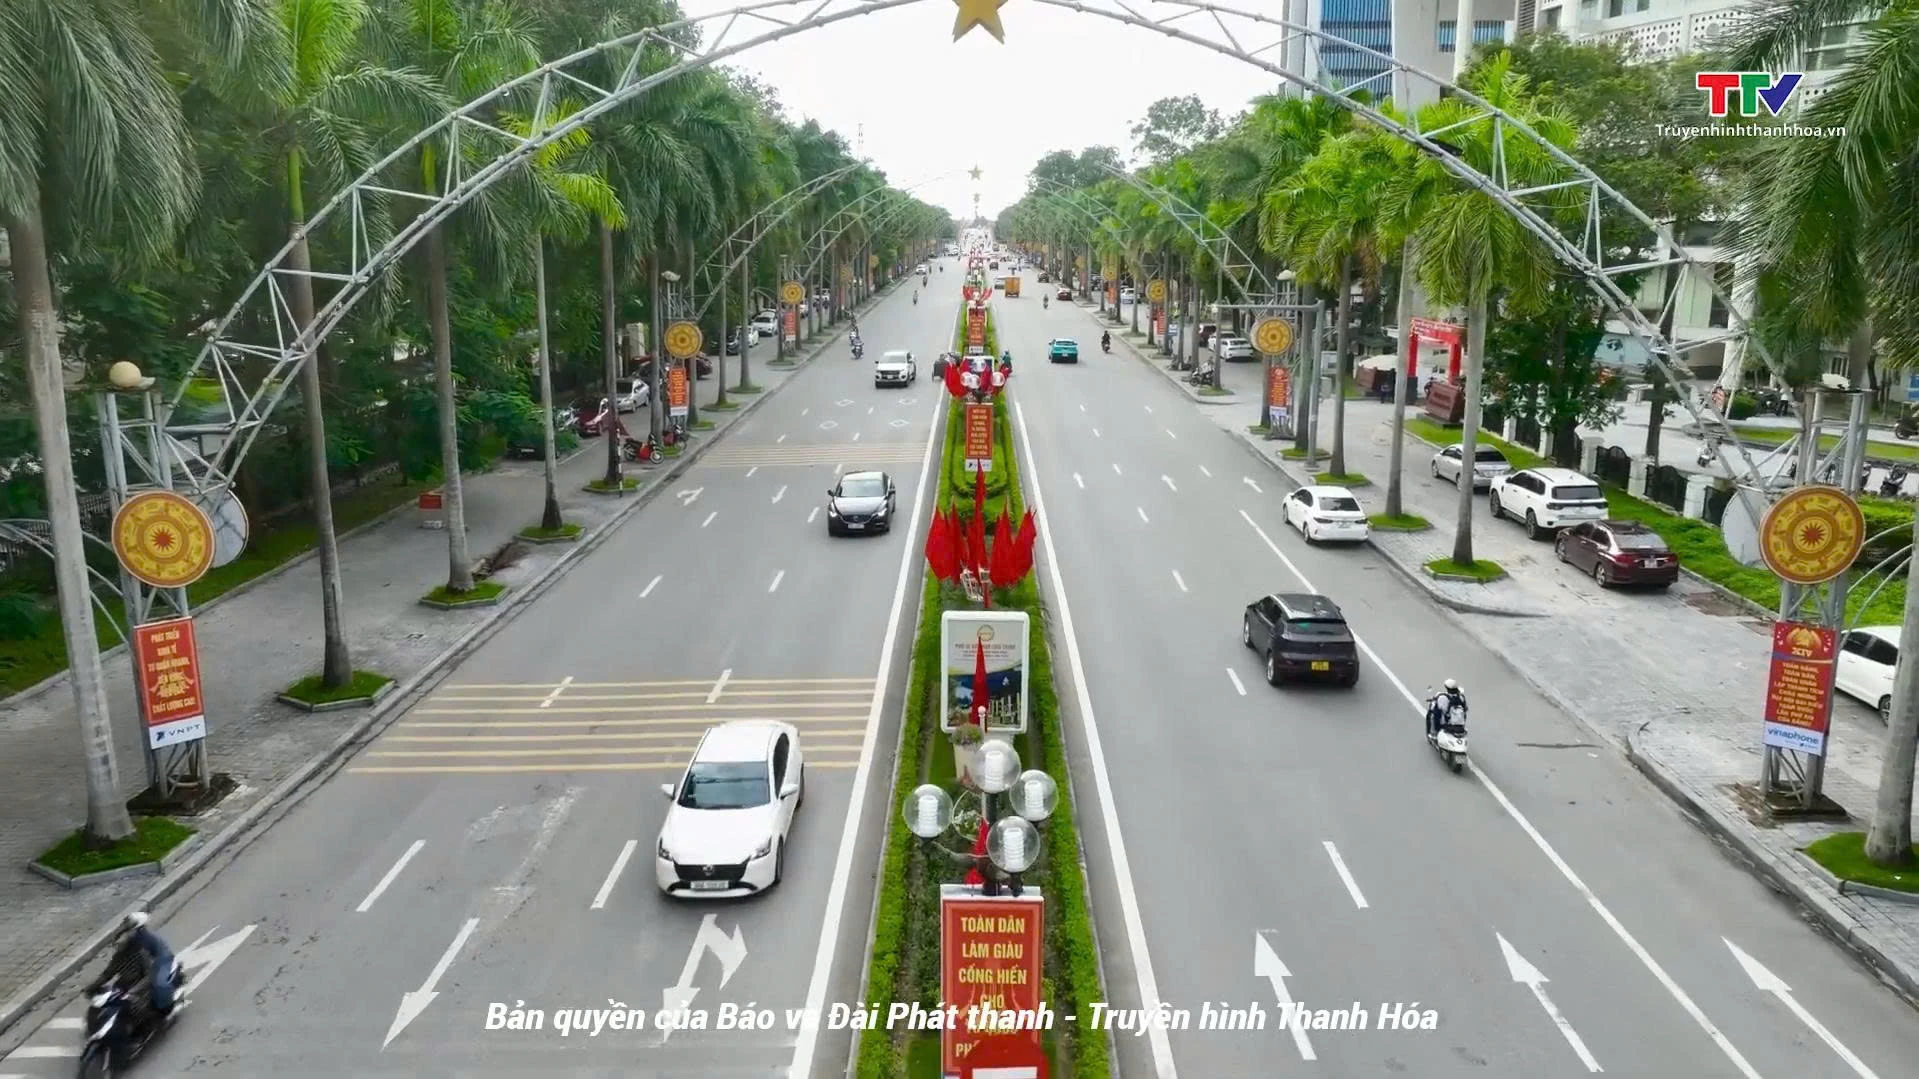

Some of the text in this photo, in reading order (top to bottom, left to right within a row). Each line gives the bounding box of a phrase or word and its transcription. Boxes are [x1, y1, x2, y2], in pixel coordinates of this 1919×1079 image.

[168, 724, 201, 737] VNPT
[1767, 727, 1819, 745] vinaphone
[960, 914, 1025, 933] TOÀN DÂN
[962, 940, 1024, 959] LÀM GIÀU
[958, 963, 1027, 985] CỐNG HIẾN
